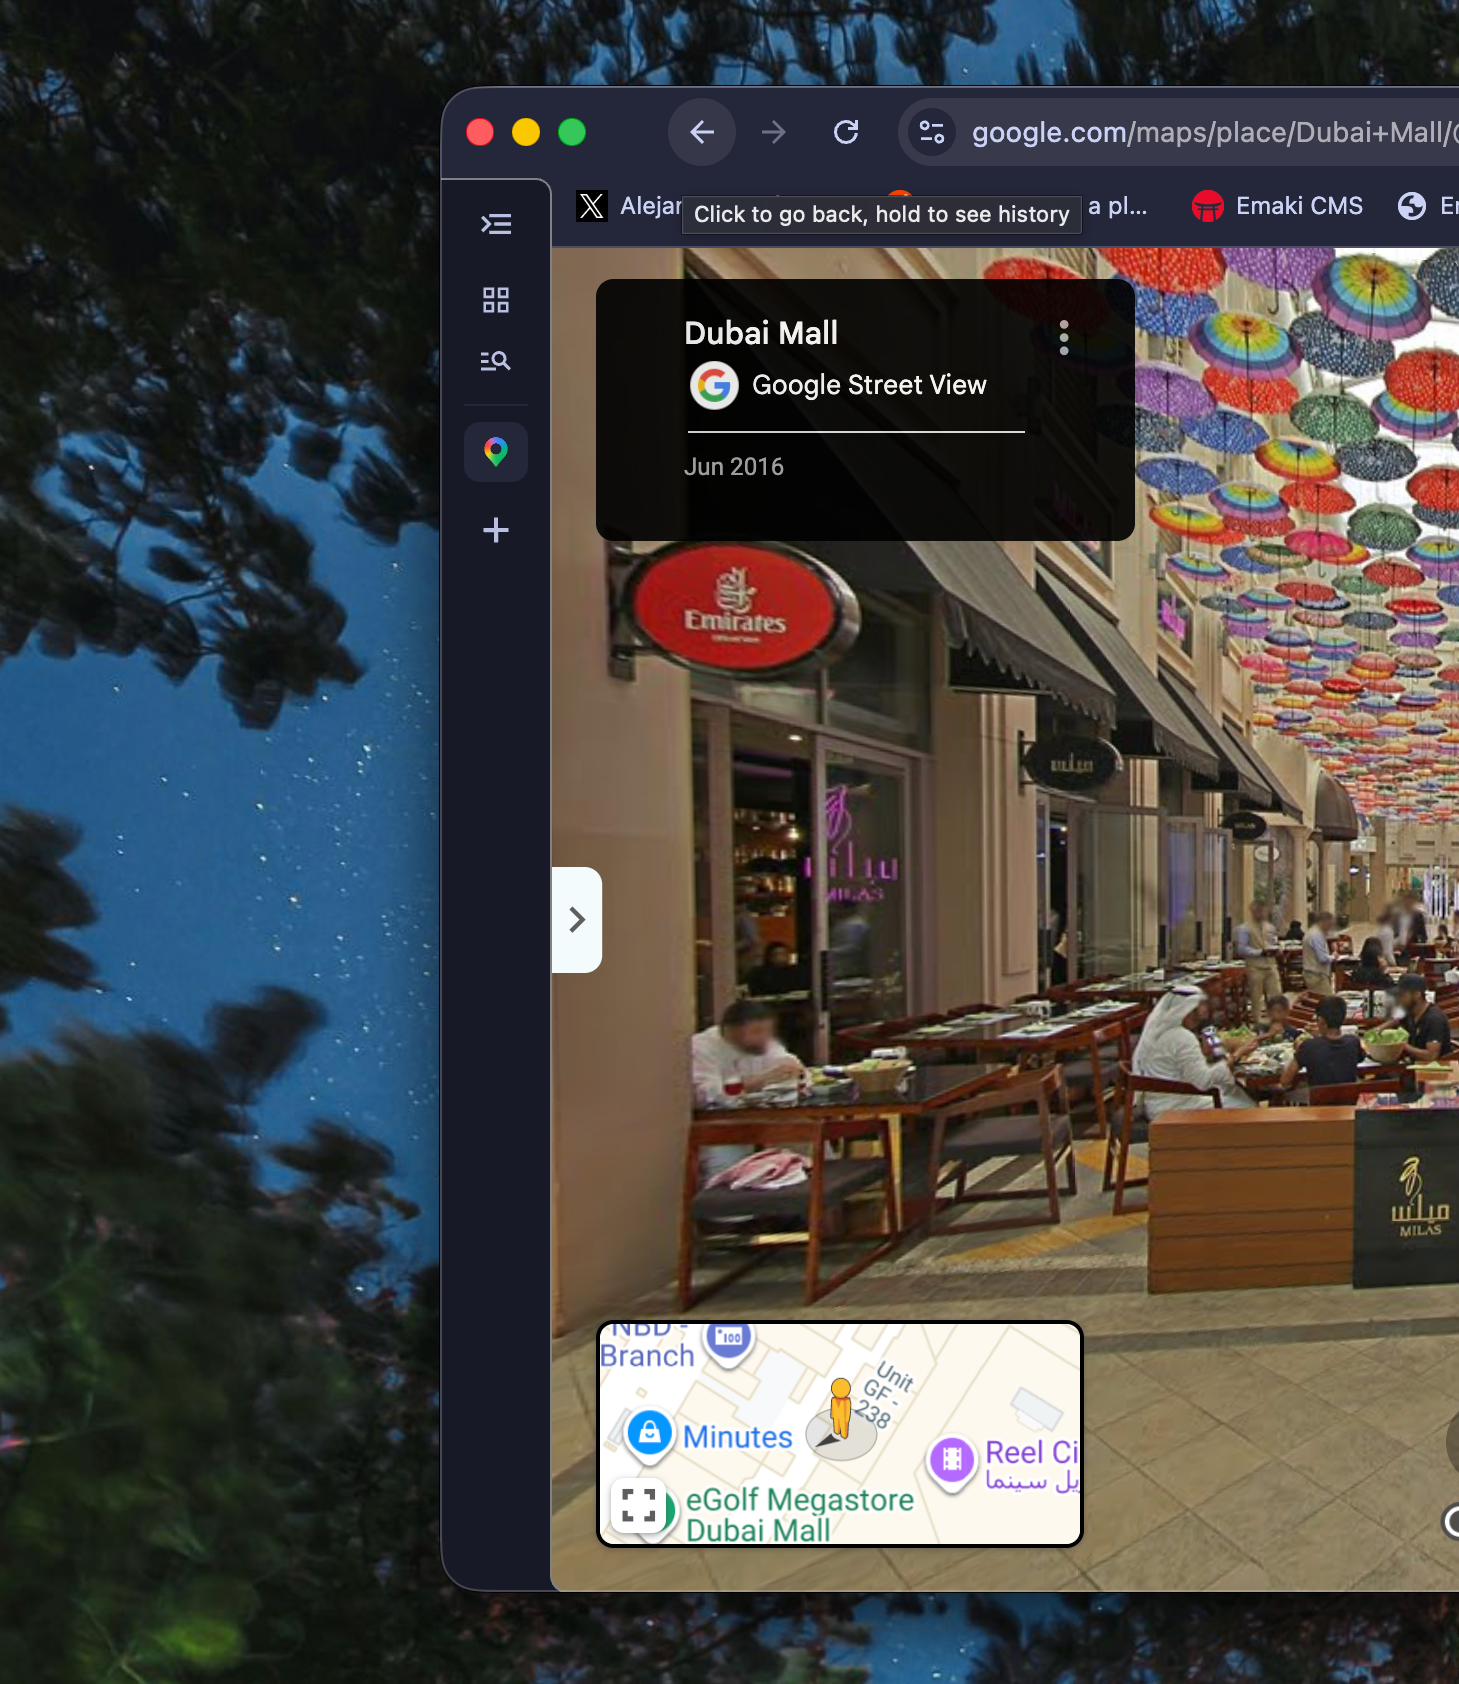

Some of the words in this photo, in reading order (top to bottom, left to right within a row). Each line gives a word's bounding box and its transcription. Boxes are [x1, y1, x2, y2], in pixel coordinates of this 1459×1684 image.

[694, 204, 746, 223] Click
[751, 206, 773, 223] to
[779, 208, 806, 227] go
[812, 204, 868, 227] back,
[876, 204, 921, 223] hold
[927, 206, 949, 223] to
[955, 208, 992, 223] see
[998, 204, 1071, 227] history
[1088, 200, 1101, 215] a
[1237, 195, 1303, 215] Emaki
[1310, 195, 1364, 215] CMS
[685, 319, 769, 345] Dubai
[779, 318, 838, 346] Mall
[752, 372, 841, 401] Google
[848, 373, 923, 396] Street
[929, 372, 988, 396] View
[683, 456, 724, 476] Jun
[730, 456, 784, 476] 2016
[684, 608, 787, 633] Emirates
[1400, 1225, 1442, 1237] MILAS
[600, 1342, 695, 1367] Branch
[877, 1360, 914, 1393] Unit
[864, 1379, 893, 1401] GF
[854, 1399, 891, 1429] 238
[684, 1424, 793, 1449] Minutes
[986, 1439, 1043, 1464] Reel
[1052, 1440, 1078, 1464] Ci
[986, 1469, 1047, 1493] سينما
[686, 1486, 760, 1512] eGolf
[768, 1487, 915, 1517] Megastore
[687, 1517, 764, 1543] Dubai
[774, 1517, 830, 1542] Mall
